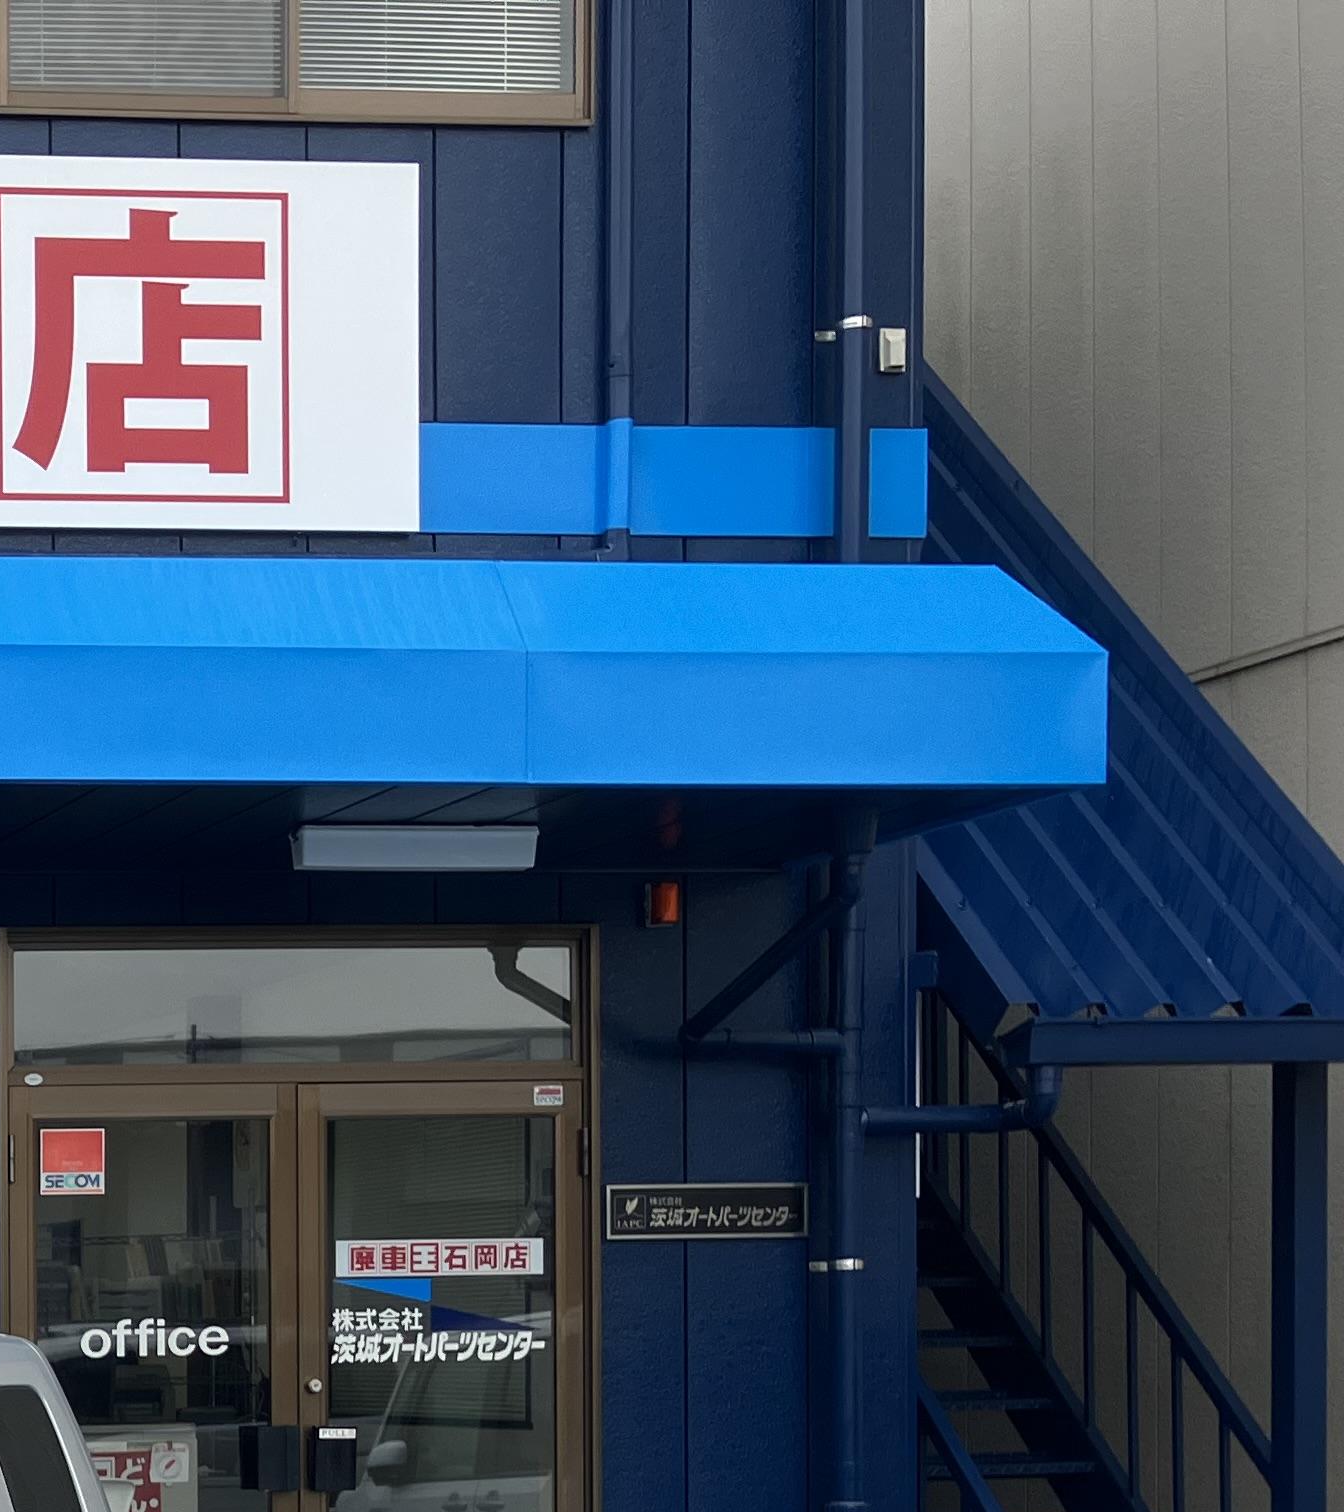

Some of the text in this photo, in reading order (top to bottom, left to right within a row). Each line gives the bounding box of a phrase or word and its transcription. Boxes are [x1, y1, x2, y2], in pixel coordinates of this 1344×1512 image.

[44, 1173, 100, 1188] SECOM
[649, 1205, 799, 1228] 茨城オートパーツセンター
[350, 1242, 530, 1273] 廃車王石岡店
[332, 1307, 424, 1332] 株式会社
[80, 1318, 230, 1359] office
[330, 1330, 546, 1365] 茨城オートパーツセンター
